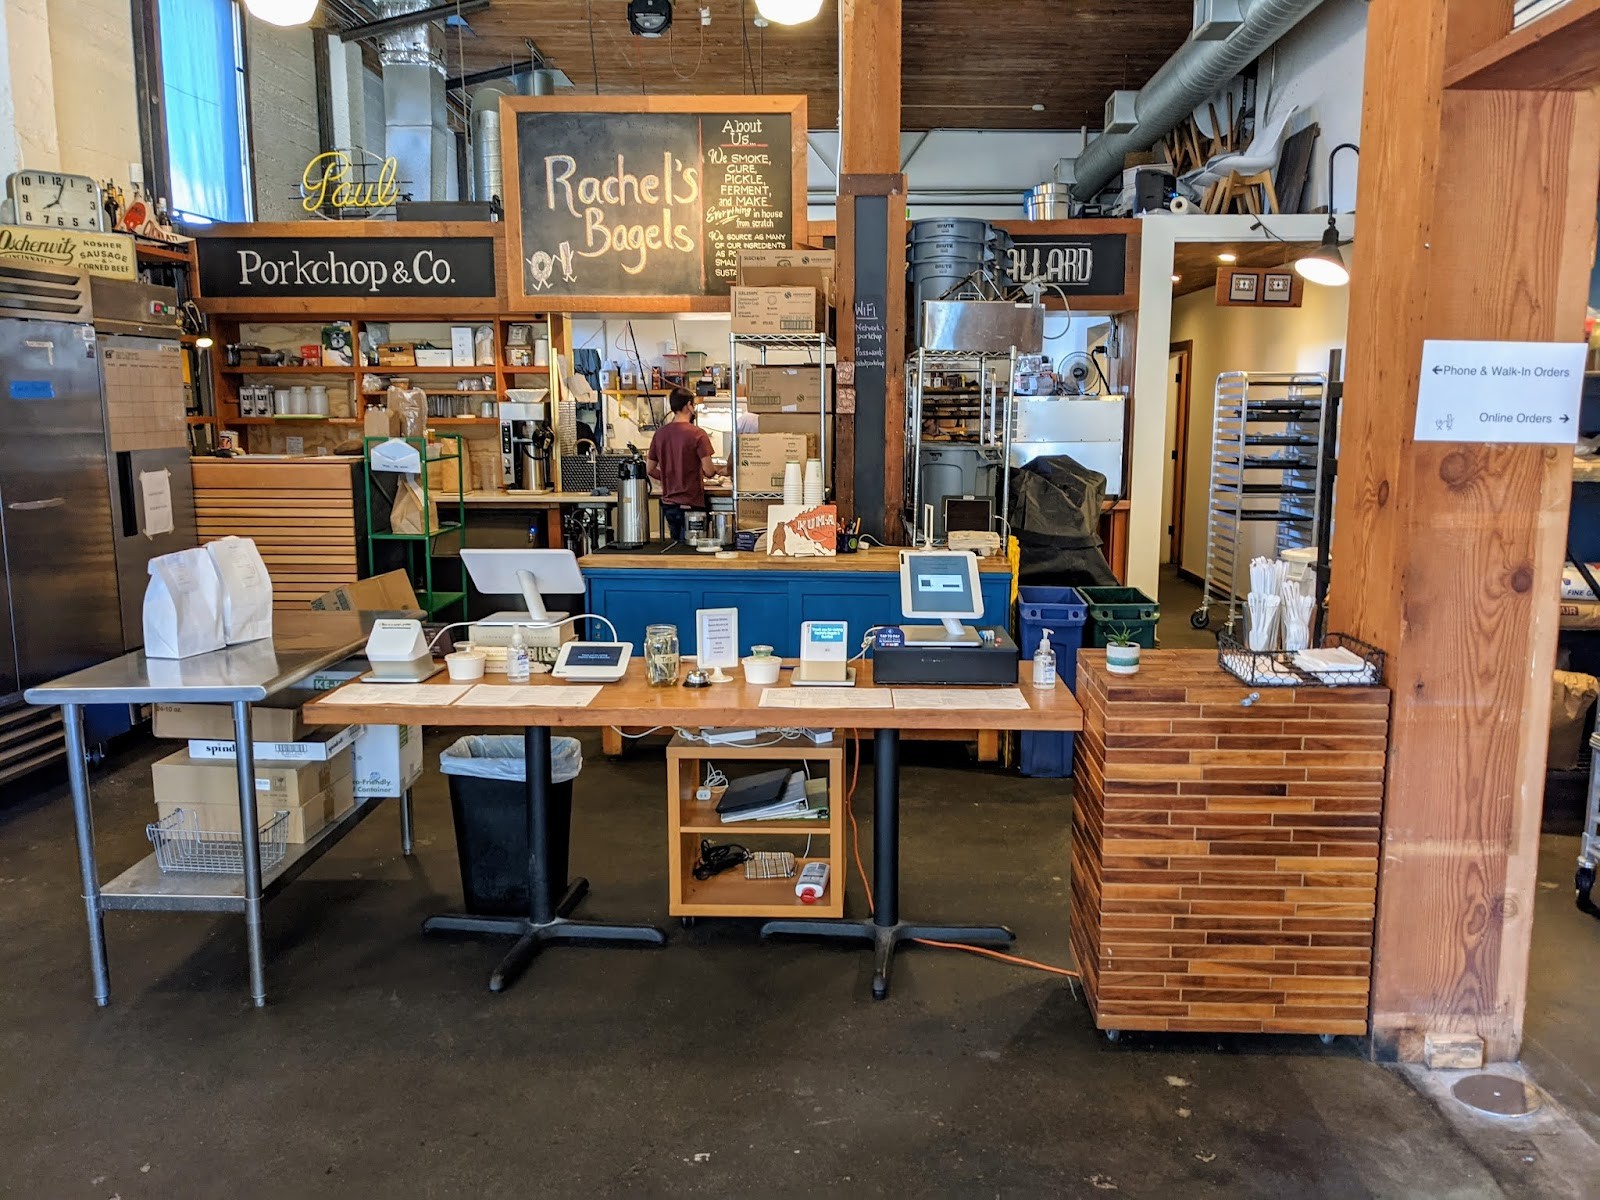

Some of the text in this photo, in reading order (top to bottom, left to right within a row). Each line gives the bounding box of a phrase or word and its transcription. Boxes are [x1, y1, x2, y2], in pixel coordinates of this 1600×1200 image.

[721, 118, 763, 133] About
[707, 147, 772, 166] We SMOKE,
[726, 164, 758, 174] CURE,
[21, 176, 31, 186] 10
[38, 175, 45, 185] 11
[52, 176, 62, 186] 12
[302, 151, 400, 211] Paul
[544, 150, 699, 218] Rachel's
[724, 173, 766, 186] PICKLE,
[86, 184, 93, 193] 2
[720, 184, 772, 198] FERMENT,
[22, 194, 29, 203] 9
[718, 196, 768, 207] and MAKE
[90, 201, 96, 210] 3
[25, 212, 32, 221] 8
[43, 215, 50, 224] 7
[705, 205, 784, 223] Everything in house
[57, 217, 64, 226] 6
[73, 217, 79, 227] 5
[88, 217, 95, 227] 4
[735, 217, 774, 228] from scratch
[708, 229, 787, 241] We SOURCE AS MANY
[83, 239, 122, 250] KOSHER
[577, 207, 696, 275] Bagels
[714, 241, 787, 250] OF OUR INGREDIENTS
[79, 250, 129, 263] SAUSAGE
[715, 250, 726, 258] AS
[78, 262, 130, 273] CORNED BEEF
[236, 250, 456, 292] Porkchop & Co.
[1442, 365, 1570, 378] Phone & Walk-In Orders
[1479, 412, 1552, 424] Online Orders
[797, 514, 835, 531] KUMA
[205, 743, 236, 755] spind
